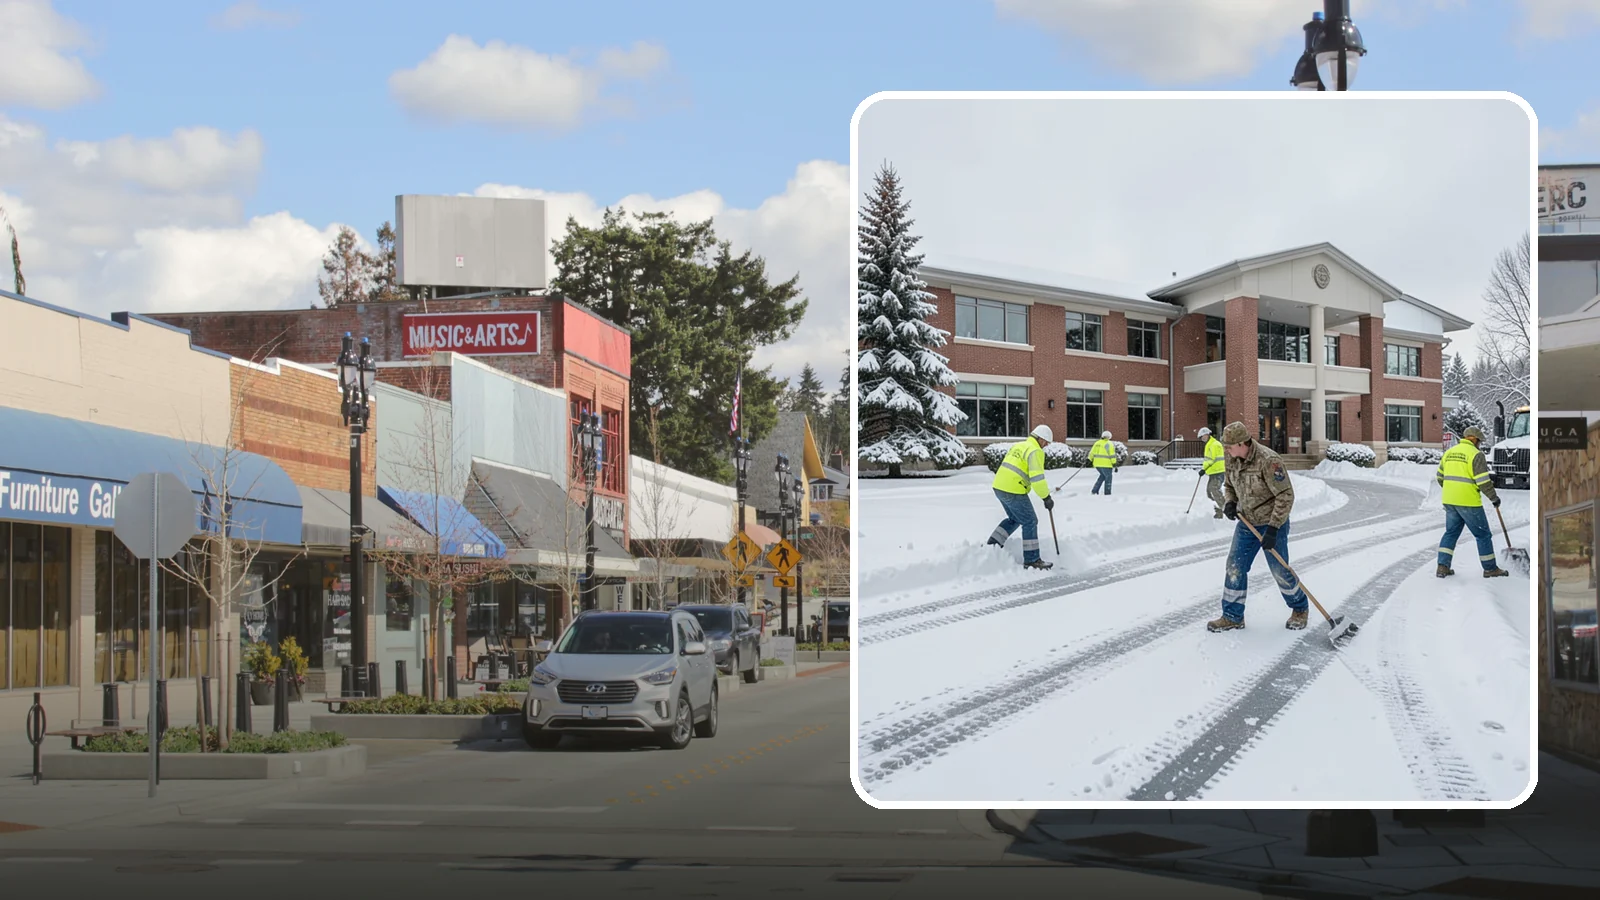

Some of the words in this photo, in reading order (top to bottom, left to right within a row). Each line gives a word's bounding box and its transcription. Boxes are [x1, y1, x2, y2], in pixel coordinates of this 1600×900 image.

[409, 323, 519, 349] MUSIC&ARTS
[0, 471, 79, 515] Furniture
[89, 482, 122, 519] Gal
[453, 563, 479, 574] SUSHI
